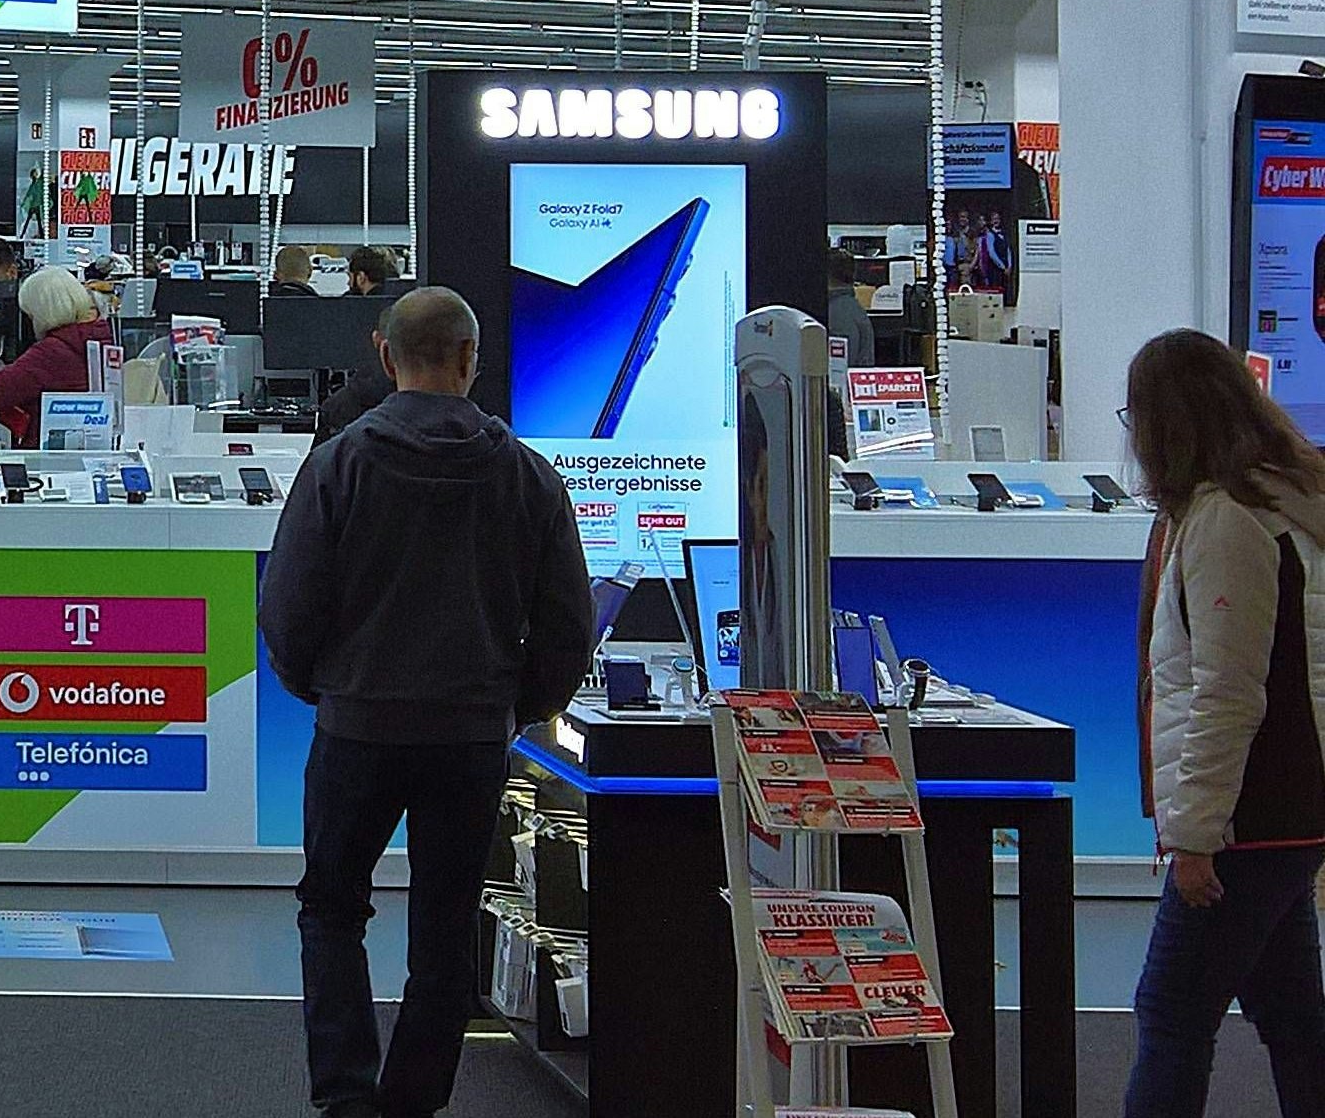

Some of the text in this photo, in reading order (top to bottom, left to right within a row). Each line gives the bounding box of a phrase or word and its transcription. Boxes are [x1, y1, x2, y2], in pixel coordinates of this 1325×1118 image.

[216, 82, 350, 132] FINAZIERUNG
[480, 86, 782, 141] SAMSUNG
[61, 170, 111, 189] CLER
[1264, 164, 1308, 191] Cyber
[539, 203, 623, 216] Galaxy Z Fold7
[549, 218, 588, 230] Galaxy
[552, 452, 706, 475] Ausgezeichnete
[575, 503, 617, 516] CHIP
[665, 516, 685, 526] GUT
[48, 681, 166, 706] vodafone
[15, 740, 149, 766] Telefónica
[821, 903, 876, 914] COUPON
[772, 914, 876, 928] KLASSIKER!
